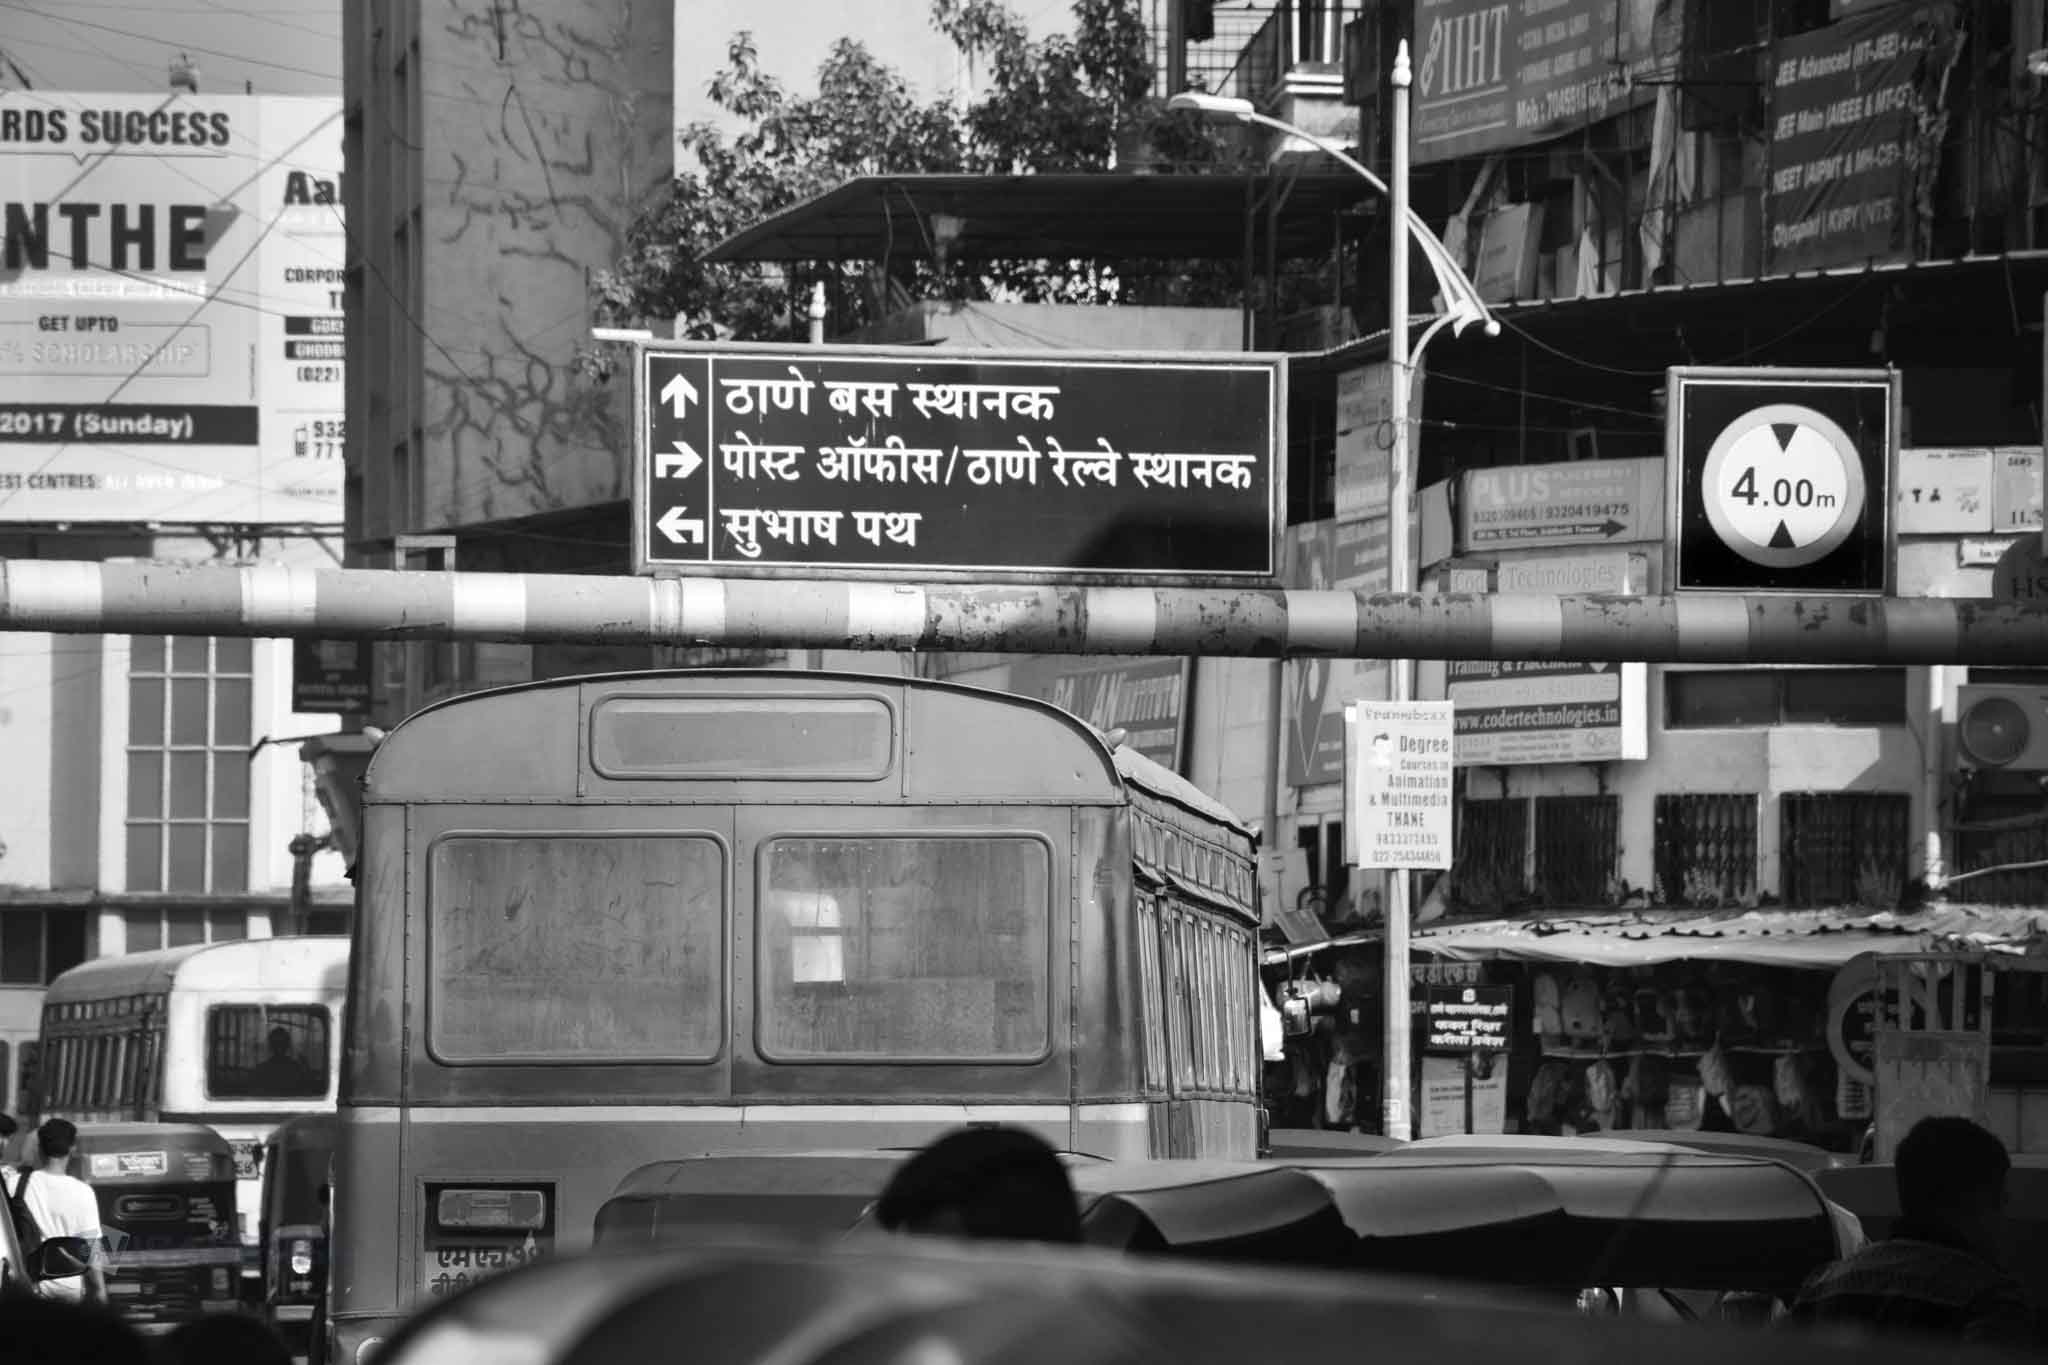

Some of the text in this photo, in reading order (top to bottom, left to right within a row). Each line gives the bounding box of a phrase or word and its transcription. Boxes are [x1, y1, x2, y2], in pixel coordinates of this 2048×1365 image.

[0, 108, 231, 146] RDS SUCCESS
[283, 171, 345, 205] Aa
[38, 316, 118, 332] GET UPTO
[31, 342, 194, 367] SCHOLARSHIP
[719, 365, 1061, 420] ठाणे बस स्थानक
[0, 412, 193, 439] 2017 (Sunday)
[719, 430, 805, 481] पोस्ट
[1045, 435, 1123, 487] रेल्वे
[1127, 452, 1257, 490] स्थानक
[1472, 471, 1550, 506] PLUS
[719, 508, 922, 558] सुभाष पथ
[1399, 735, 1449, 754] Degree
[1387, 774, 1449, 789] Animation
[1381, 792, 1448, 807] Multimedia
[1387, 811, 1425, 827] THANE
